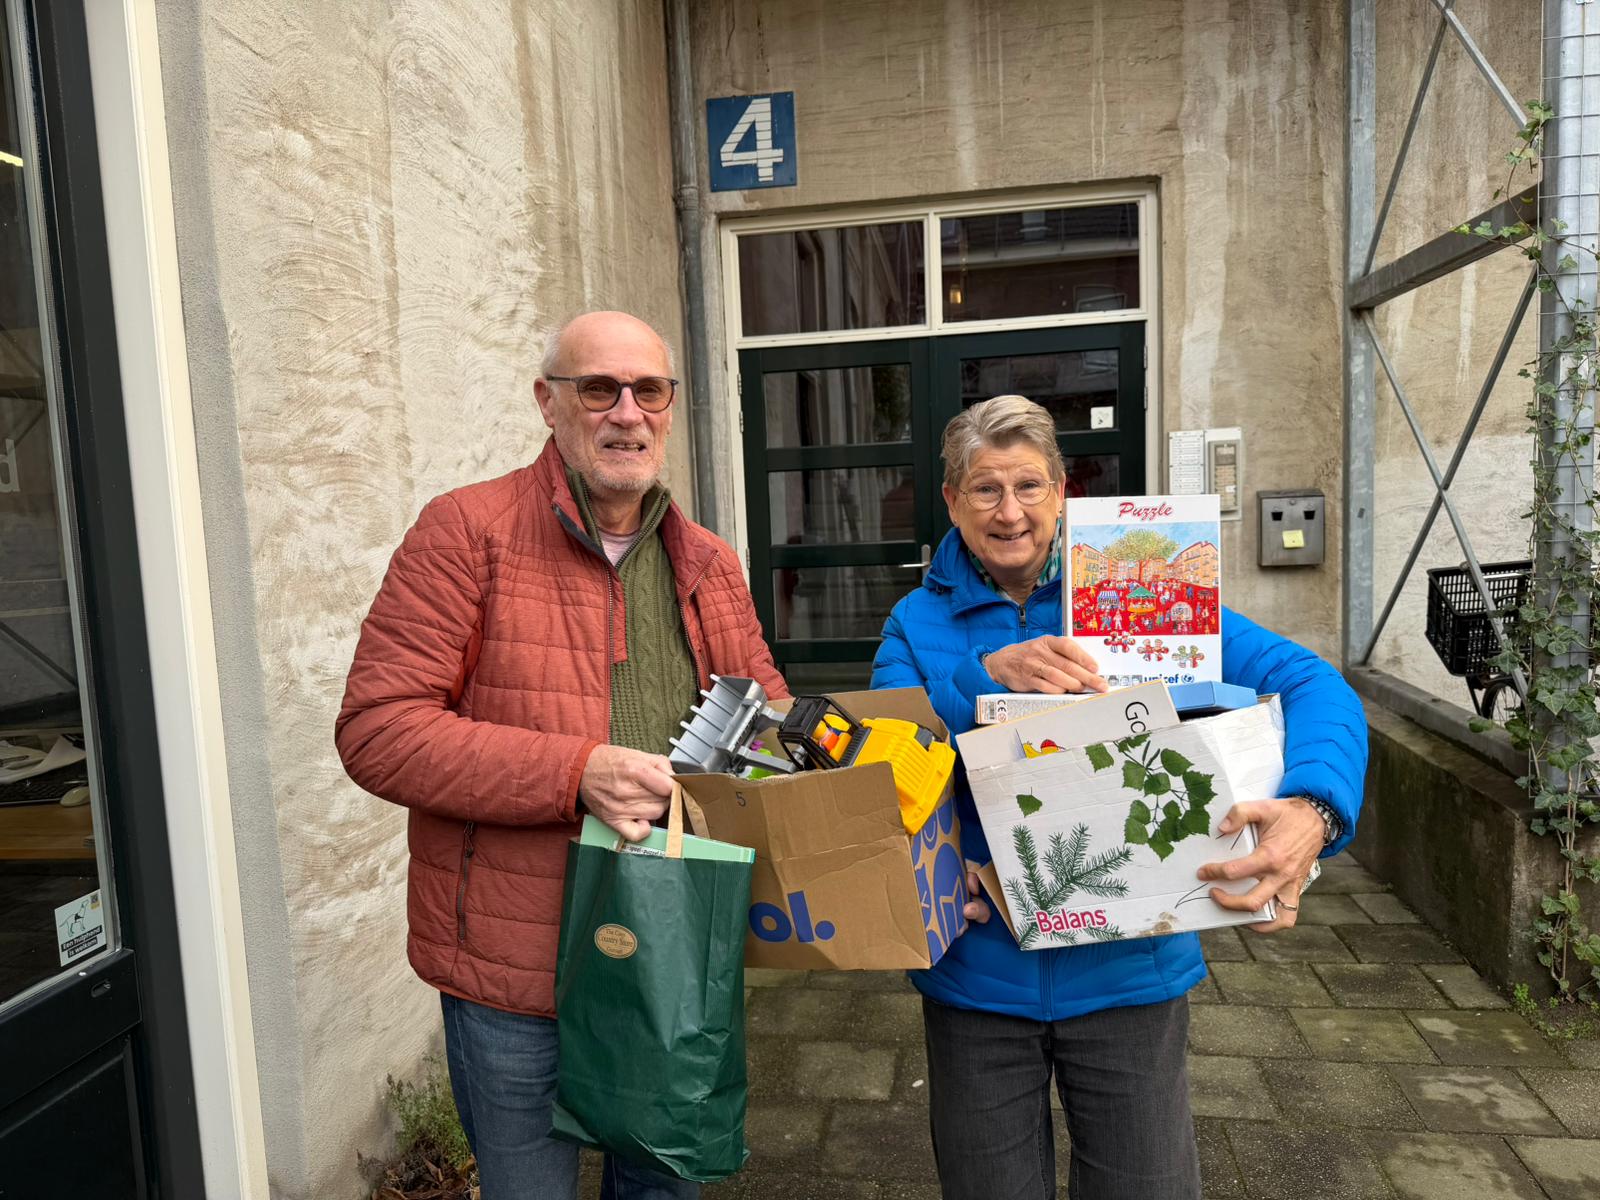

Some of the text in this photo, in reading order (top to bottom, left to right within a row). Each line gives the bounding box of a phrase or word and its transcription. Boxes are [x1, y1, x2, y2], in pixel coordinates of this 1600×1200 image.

[720, 98, 783, 182] 4
[1118, 501, 1173, 521] Puzzle
[1125, 701, 1150, 734] Go
[1035, 908, 1107, 933] Balans
